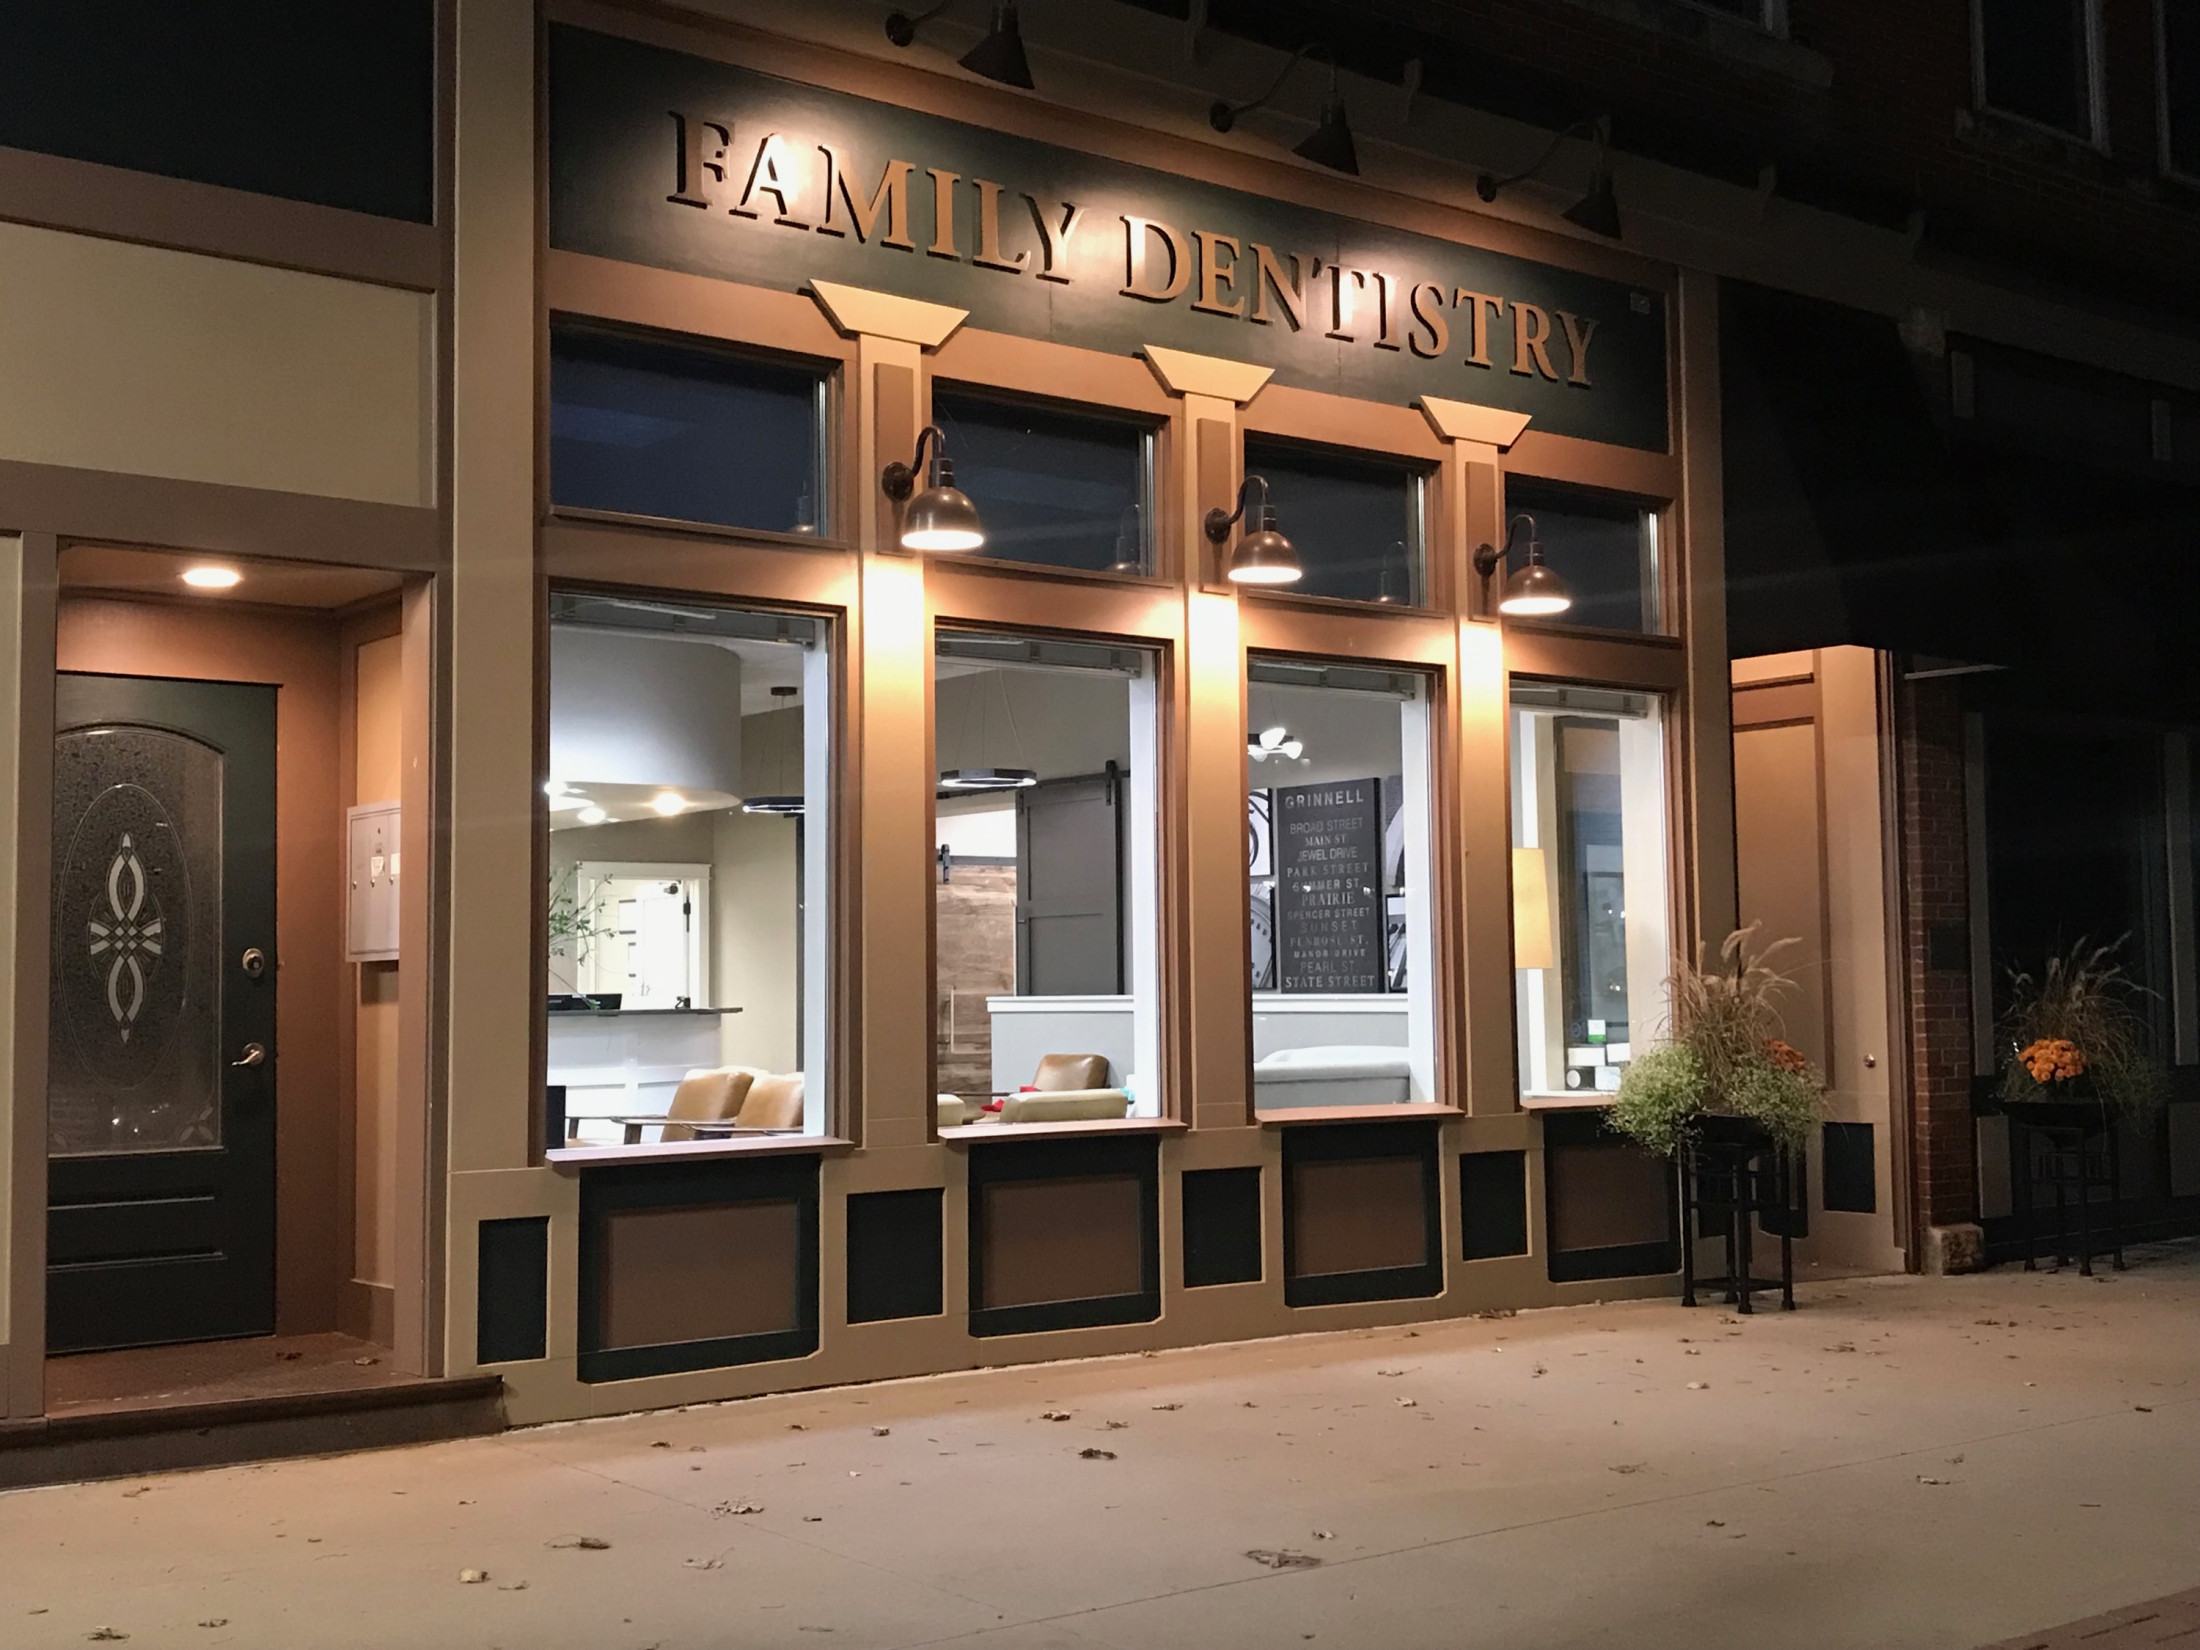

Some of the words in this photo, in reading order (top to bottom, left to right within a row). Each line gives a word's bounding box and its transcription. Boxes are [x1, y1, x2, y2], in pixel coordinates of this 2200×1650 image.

[666, 110, 1085, 284] FAMILY
[1118, 215, 1598, 388] DENTISTRY
[1285, 789, 1364, 809] GRINNELL
[1290, 821, 1323, 835] BROAD
[1327, 817, 1363, 831] STREET
[1305, 835, 1331, 846] MAIN
[1297, 849, 1327, 862] JEWEL
[1330, 846, 1358, 859] DRIVE
[1287, 865, 1317, 877] PARK
[1323, 862, 1368, 875] STREET
[1302, 892, 1355, 906] PRAIRIE
[1287, 909, 1330, 920] SPENCER
[1334, 907, 1369, 918] STREET
[1300, 920, 1357, 933] SUNSET
[1335, 948, 1366, 957] DRIVE
[1300, 961, 1336, 973] PEARL
[1285, 976, 1323, 988] STATE
[1328, 975, 1375, 988] STREET
